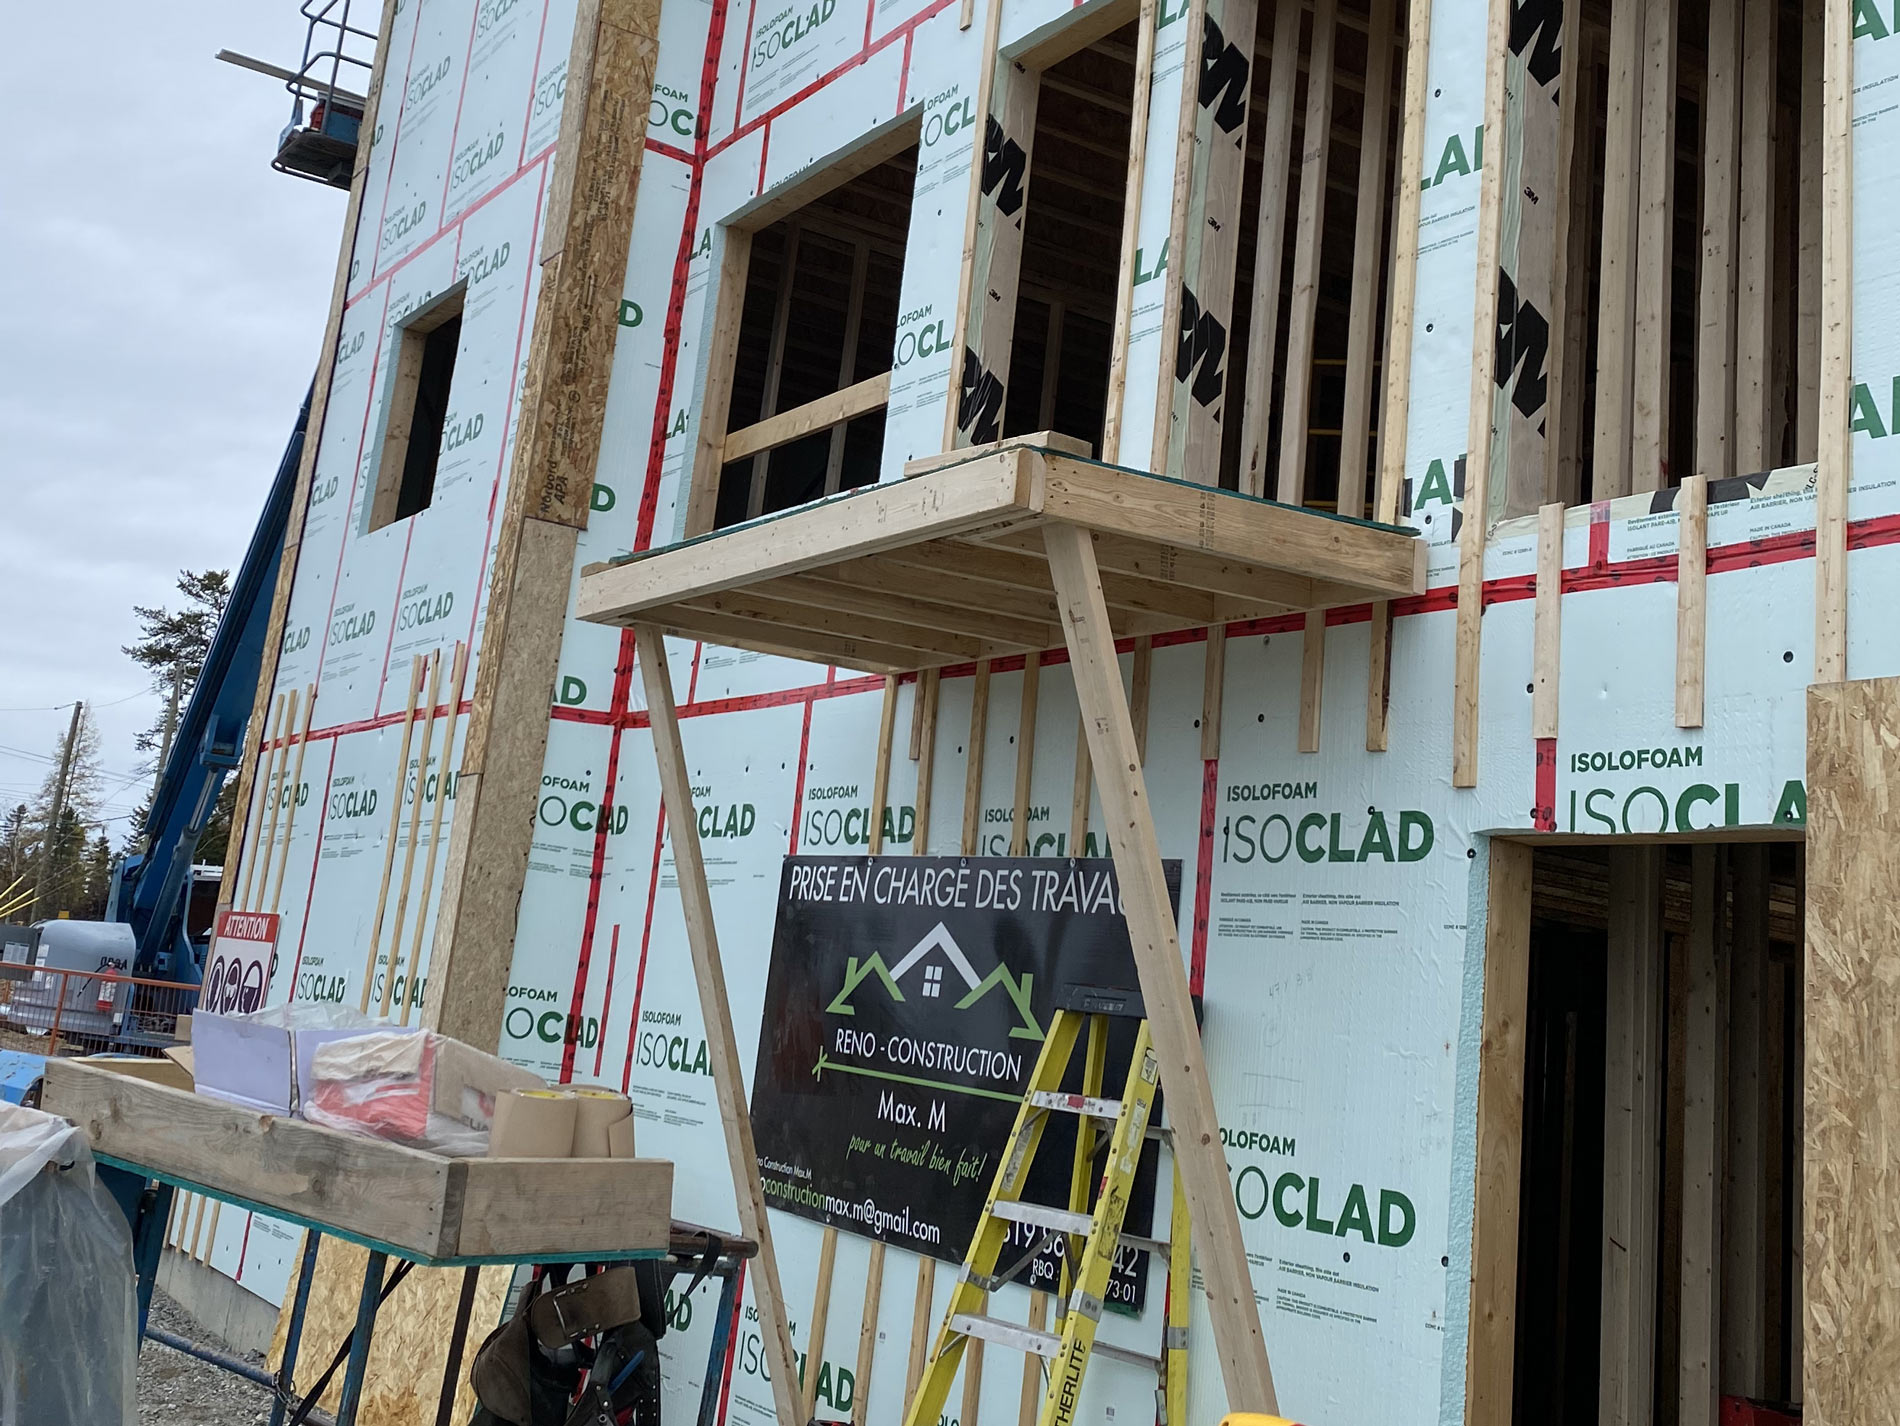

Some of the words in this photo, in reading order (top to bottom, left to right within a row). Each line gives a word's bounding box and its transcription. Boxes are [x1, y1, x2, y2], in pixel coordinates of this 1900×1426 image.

[751, 0, 836, 72] ISOCLAD
[755, 5, 794, 39] ISOLOFOAM
[405, 56, 451, 112] ISOCLAD
[923, 84, 958, 113] LOFOAM
[451, 132, 504, 192] ISOCLAD
[1523, 186, 1539, 205] 3M
[1207, 216, 1221, 232] 3M
[989, 289, 1001, 302] 3M
[896, 303, 932, 329] LOFOAM
[540, 460, 557, 514] Norbord
[553, 475, 568, 505] APA
[397, 591, 454, 633] ISOCLAD
[283, 626, 310, 655] CLAD
[329, 610, 376, 647] ISOCLAD
[1571, 746, 1703, 773] ISOLOFOAM
[542, 775, 590, 793] OFOAM
[808, 784, 858, 801] ISOLOFOAM
[1227, 782, 1318, 802] ISOLOFOAM
[327, 789, 378, 820] ISOCLAD
[1569, 779, 1808, 834] ISOCLA
[1223, 811, 1435, 864] ISOCLAD
[789, 865, 838, 902] PRISE
[839, 866, 871, 903] EN
[873, 866, 970, 908] CHARGE
[975, 869, 1023, 911] DES
[1031, 870, 1126, 915] TRAVA
[223, 915, 271, 941] ATTENTION
[296, 973, 346, 1003] ISOCLAD
[506, 986, 558, 1003] OFOAM
[642, 1010, 682, 1026] ISOLOFOAM
[835, 1028, 876, 1058] RENO
[887, 1035, 1021, 1083] CONSTRUCTION
[877, 1089, 921, 1128] Max.
[927, 1099, 946, 1133] M
[846, 1134, 871, 1160] pour
[874, 1142, 886, 1157] un
[889, 1138, 930, 1167] travail
[929, 1151, 951, 1176] bien
[953, 1148, 988, 1187] fait!
[760, 1176, 940, 1244] oconstructionmax.m@gmail.com
[1229, 1164, 1416, 1248] OCLAD
[1033, 1258, 1054, 1280] RBQ
[1106, 1279, 1137, 1303] 73-01
